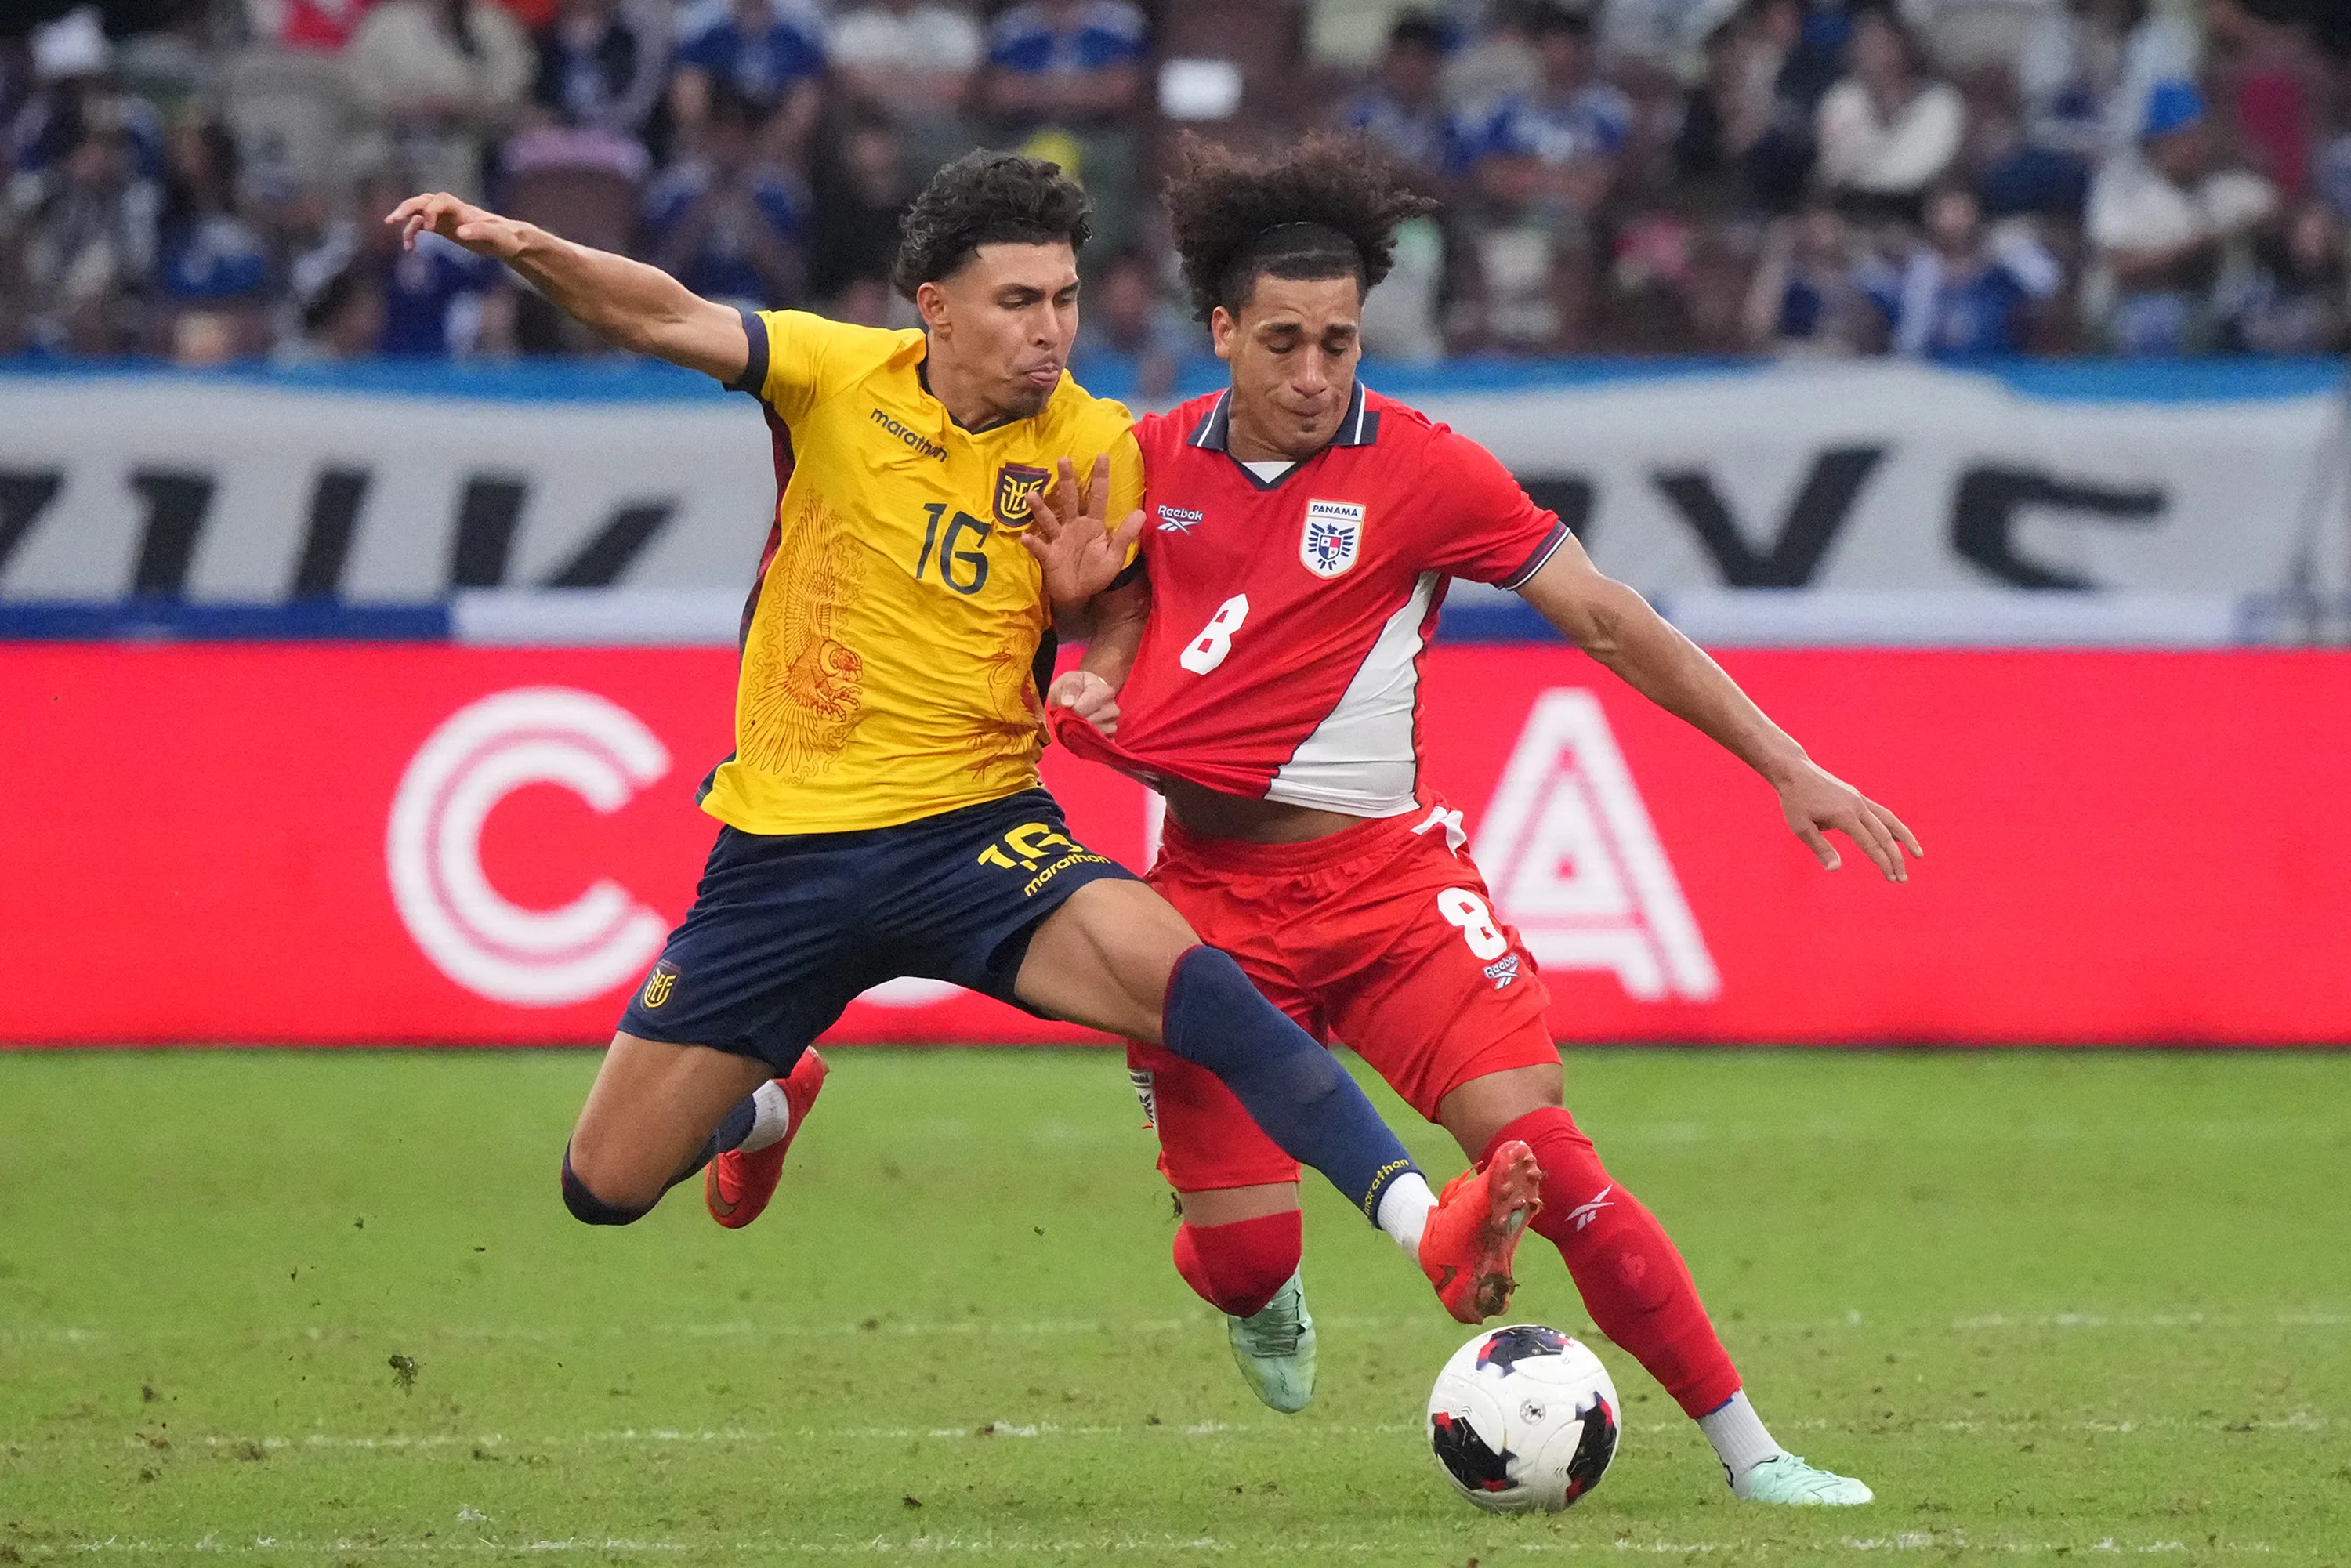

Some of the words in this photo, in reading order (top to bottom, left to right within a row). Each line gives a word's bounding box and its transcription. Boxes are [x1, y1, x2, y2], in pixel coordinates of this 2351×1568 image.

[1157, 505, 1204, 522] Reebok
[1312, 504, 1359, 518] PANAMÁ
[1179, 592, 1250, 676] 8
[1023, 853, 1112, 897] marathon
[1437, 887, 1507, 961] 8
[1483, 954, 1519, 978] Reebok
